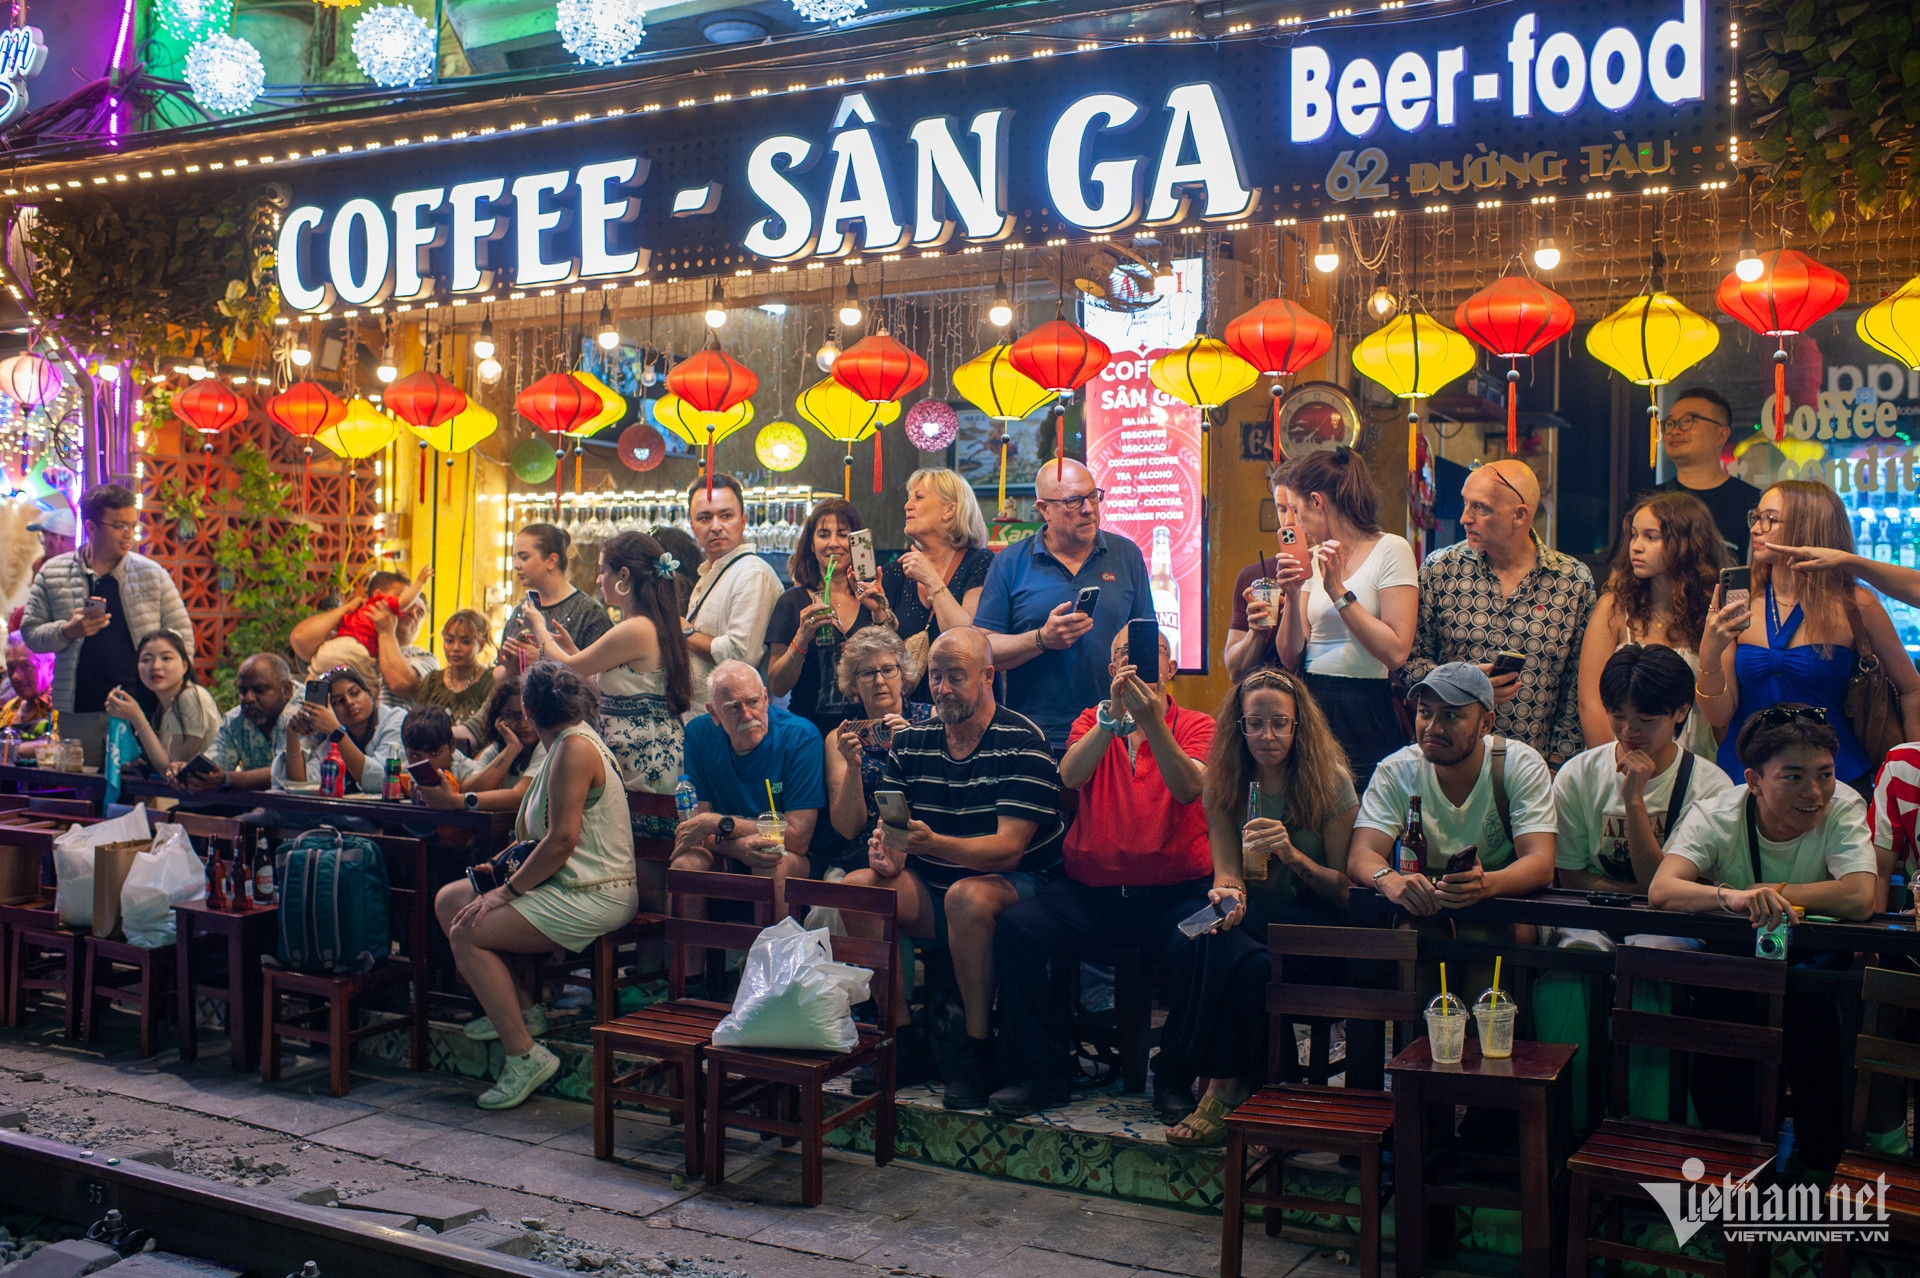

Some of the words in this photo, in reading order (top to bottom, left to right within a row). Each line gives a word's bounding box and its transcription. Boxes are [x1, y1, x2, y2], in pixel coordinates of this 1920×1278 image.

[1325, 147, 1390, 201] 62
[1406, 143, 1563, 194] ĐƯỜNG
[1580, 131, 1671, 178] TÀU
[277, 157, 652, 313] COFFEE
[744, 90, 1017, 262] SÂN
[1044, 81, 1262, 235] GA
[1101, 384, 1147, 410] SÂN
[1760, 391, 1898, 441] Coffee
[1122, 418, 1136, 426] BIA
[1121, 430, 1167, 439] EGGCOFFEE
[1122, 443, 1167, 453] EGGCACAO
[1107, 458, 1147, 467] COCONUT
[1148, 456, 1179, 465] COFFEE
[1116, 473, 1132, 481] TEA
[1109, 485, 1132, 494] JUICE
[1137, 484, 1179, 493] SMOOTHIE
[1106, 499, 1139, 508] YOGURT
[1143, 497, 1183, 506] COCKTAIL
[1105, 512, 1154, 522] VIETNAMESE
[1155, 511, 1184, 520] FOODS
